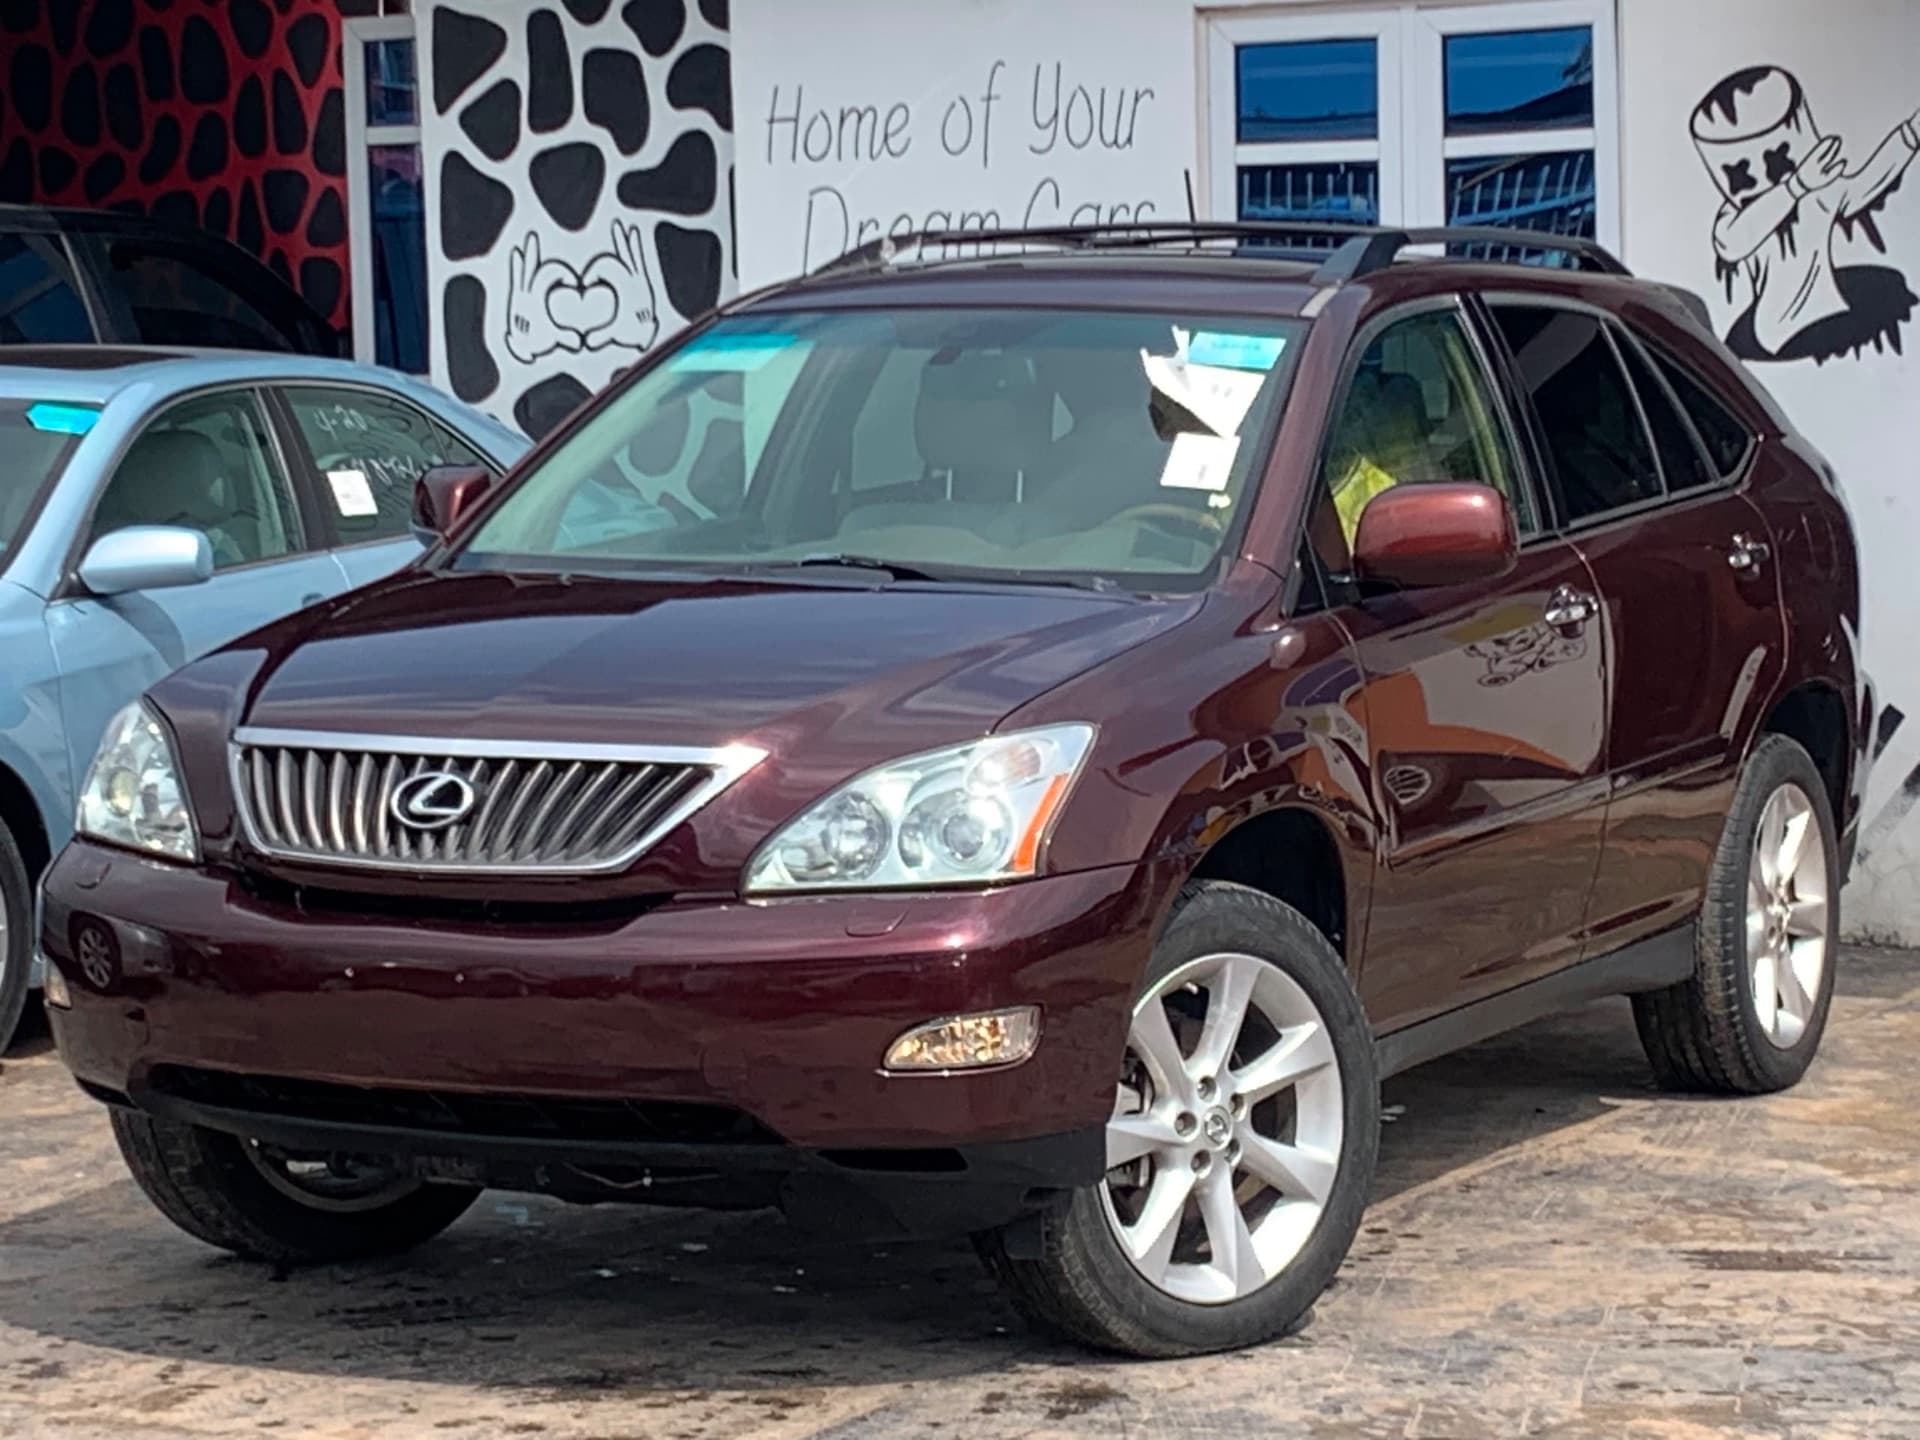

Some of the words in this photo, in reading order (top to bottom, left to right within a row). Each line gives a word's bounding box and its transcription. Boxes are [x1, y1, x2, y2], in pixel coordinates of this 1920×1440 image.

[767, 84, 912, 164] Home
[941, 60, 1006, 168] of
[1028, 61, 1155, 156] Your
